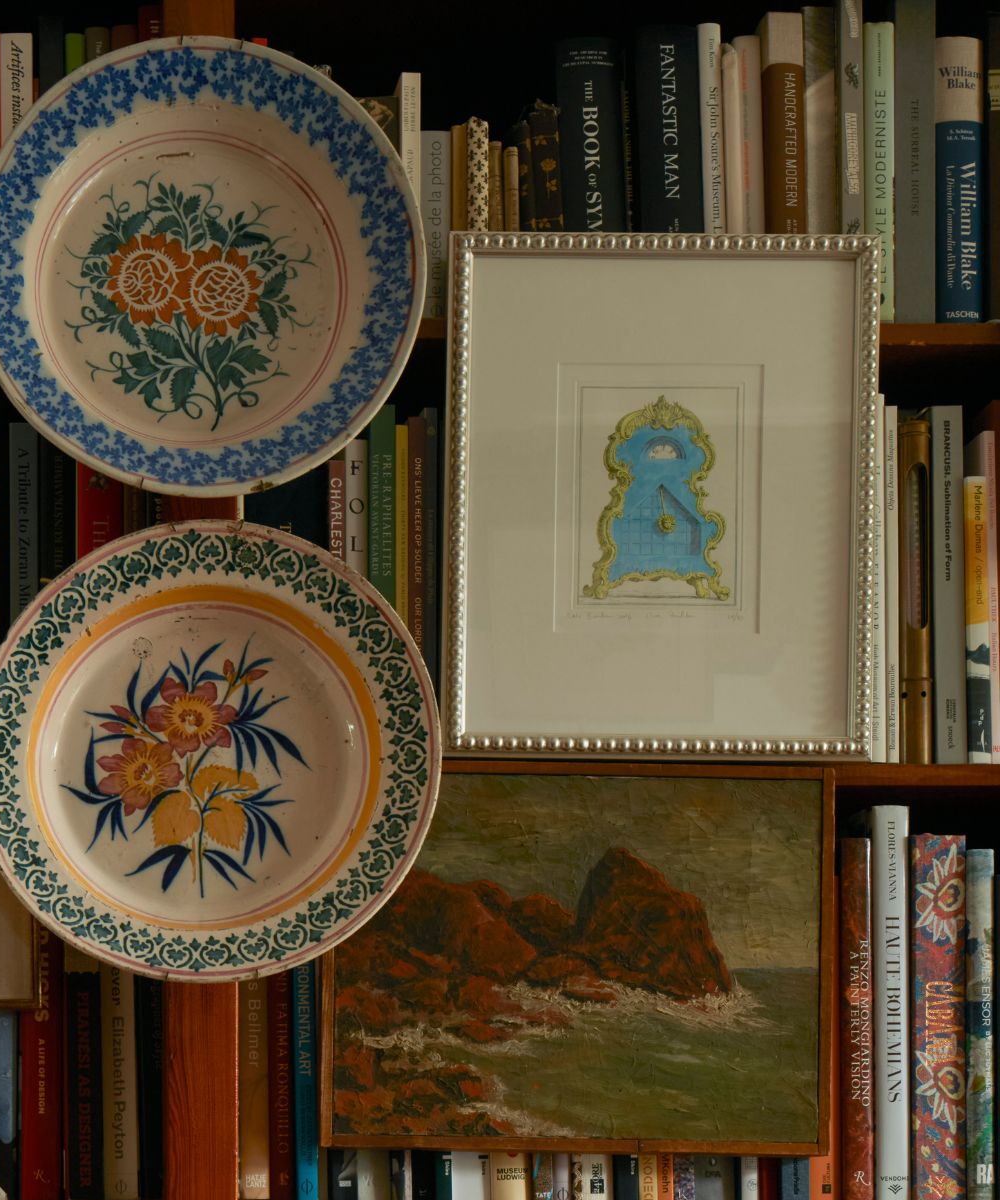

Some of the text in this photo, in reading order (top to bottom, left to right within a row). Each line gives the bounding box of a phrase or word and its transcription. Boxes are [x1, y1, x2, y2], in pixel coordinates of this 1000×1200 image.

[582, 80, 599, 187] THE BOOK OF
[659, 44, 680, 199] FANTASTIC MAN
[706, 86, 722, 222] Sir John Soane's Museum,
[783, 73, 797, 206] HANDCRAFTED MODERN
[874, 90, 886, 198] MODERNISTE
[959, 162, 977, 290] William Blake
[382, 454, 392, 577] PRE-RAPHAELITES
[943, 420, 952, 580] BRANCUSI. Sublimation of Form
[248, 999, 261, 1068] Bellmer
[850, 951, 861, 1101] A PAINTERLY VISION
[860, 939, 872, 1107] RENZO MONGIARDINO
[884, 916, 902, 1103] HAUTE BOHEMIANS
